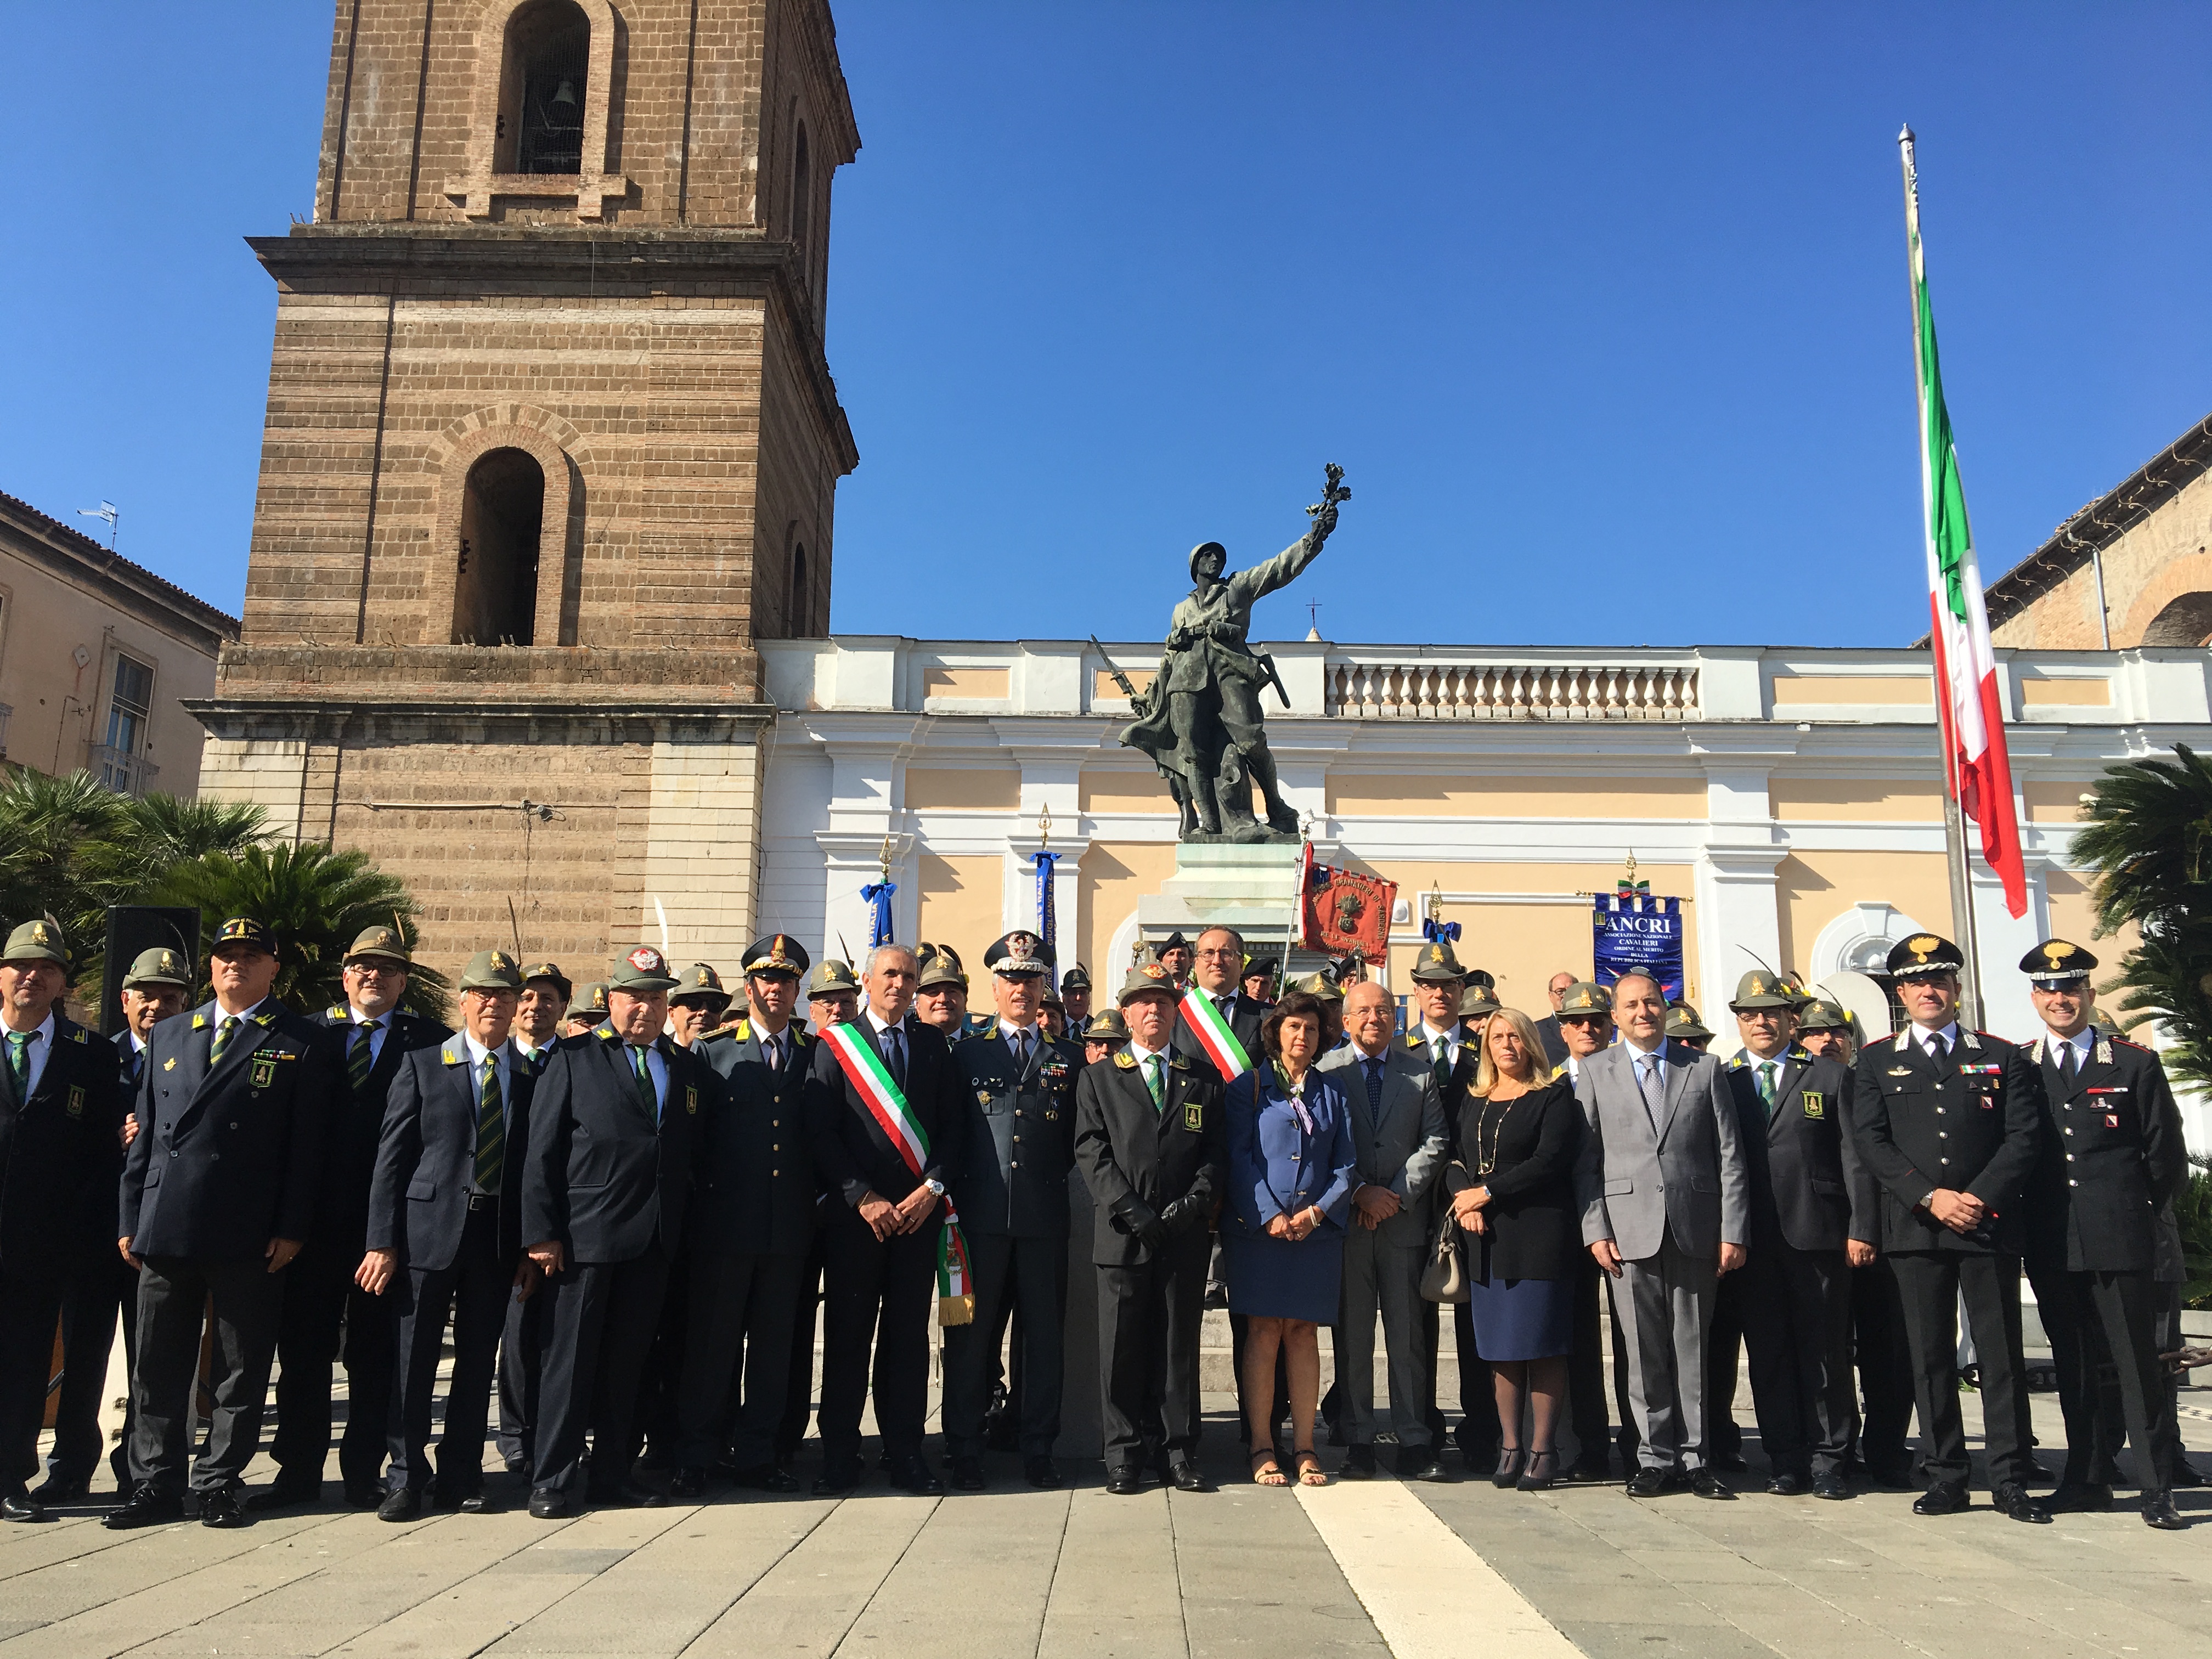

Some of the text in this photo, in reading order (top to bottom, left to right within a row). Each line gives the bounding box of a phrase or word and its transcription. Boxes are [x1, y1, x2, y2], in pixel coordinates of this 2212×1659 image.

[1047, 872, 1053, 881] C.
[1048, 883, 1053, 892] IN
[1334, 878, 1386, 940] GRANATIERI DI SARDEGNA
[222, 918, 240, 929] GUARDIA
[246, 918, 263, 929] FINANZA
[1605, 917, 1672, 933] ANCRI
[1340, 948, 1346, 956] DI
